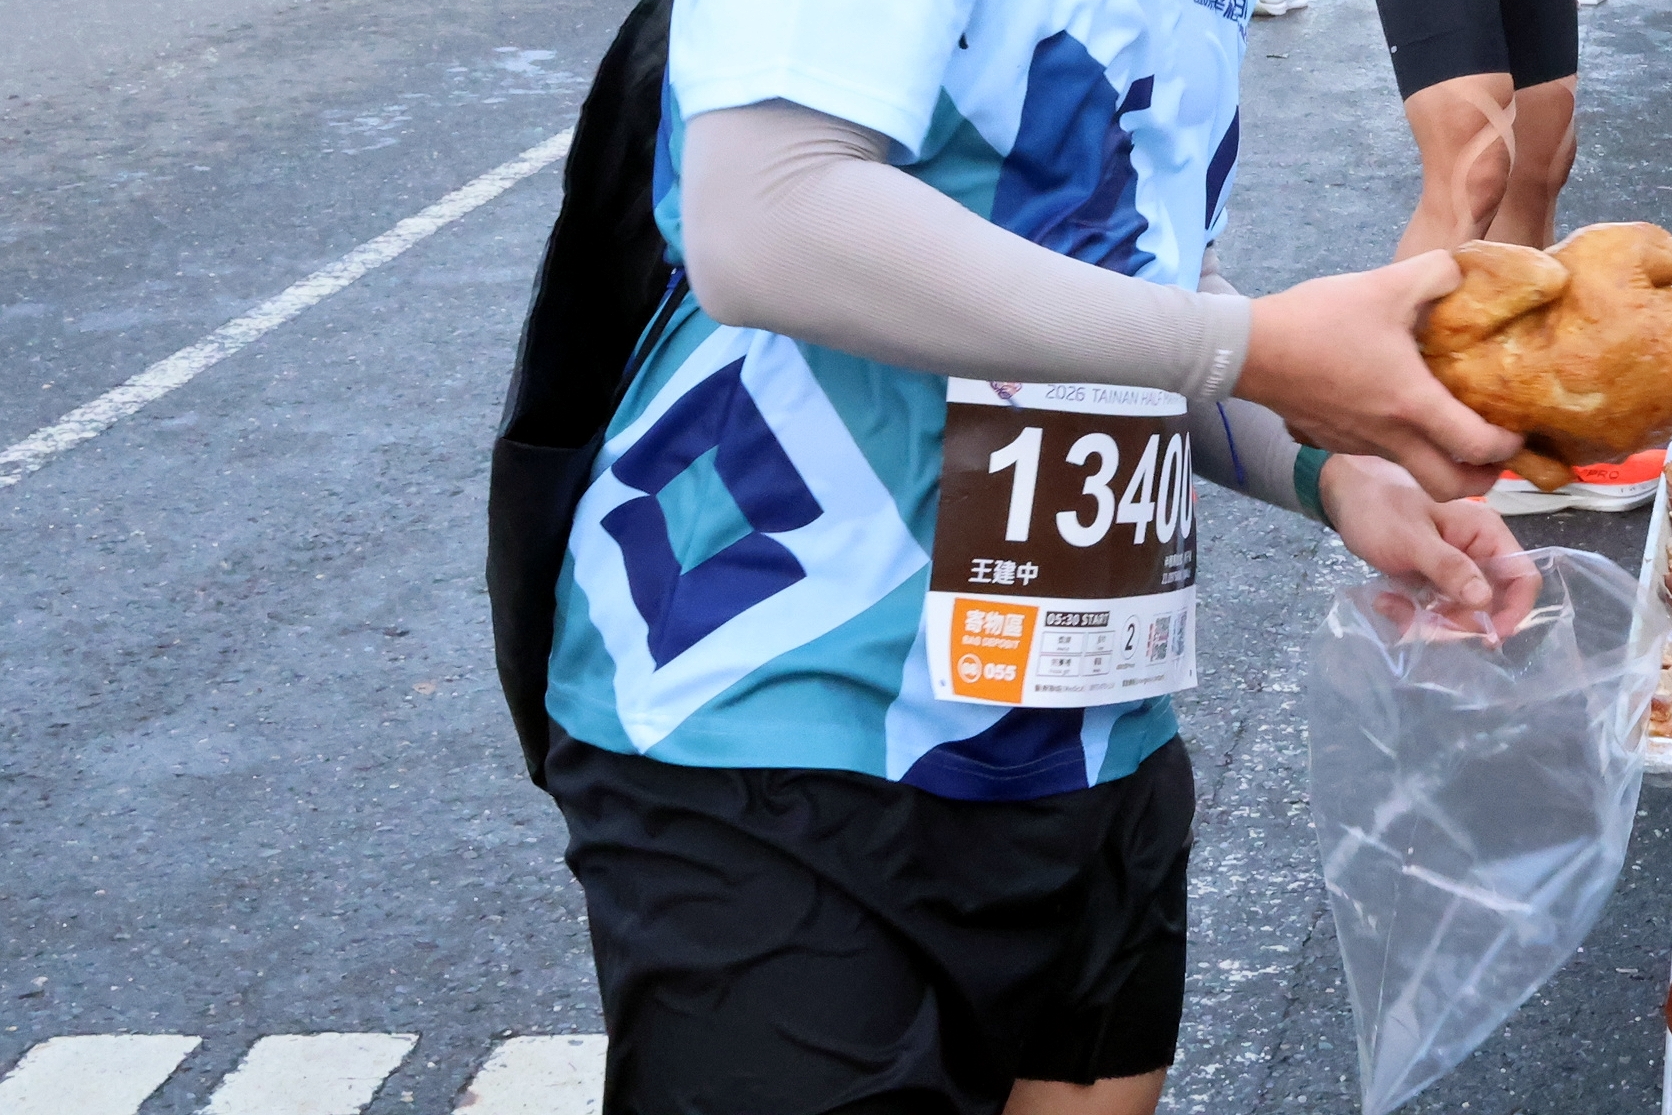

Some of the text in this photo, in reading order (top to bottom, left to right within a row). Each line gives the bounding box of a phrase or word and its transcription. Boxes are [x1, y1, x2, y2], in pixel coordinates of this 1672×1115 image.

[1045, 383, 1086, 402] 2026
[1092, 388, 1139, 406] TAINAN
[968, 558, 1039, 586] 王建中
[965, 609, 1026, 637] 寄物區
[1046, 612, 1110, 626] 05:30 START
[1124, 622, 1136, 651] 2
[983, 662, 1018, 682] 055
